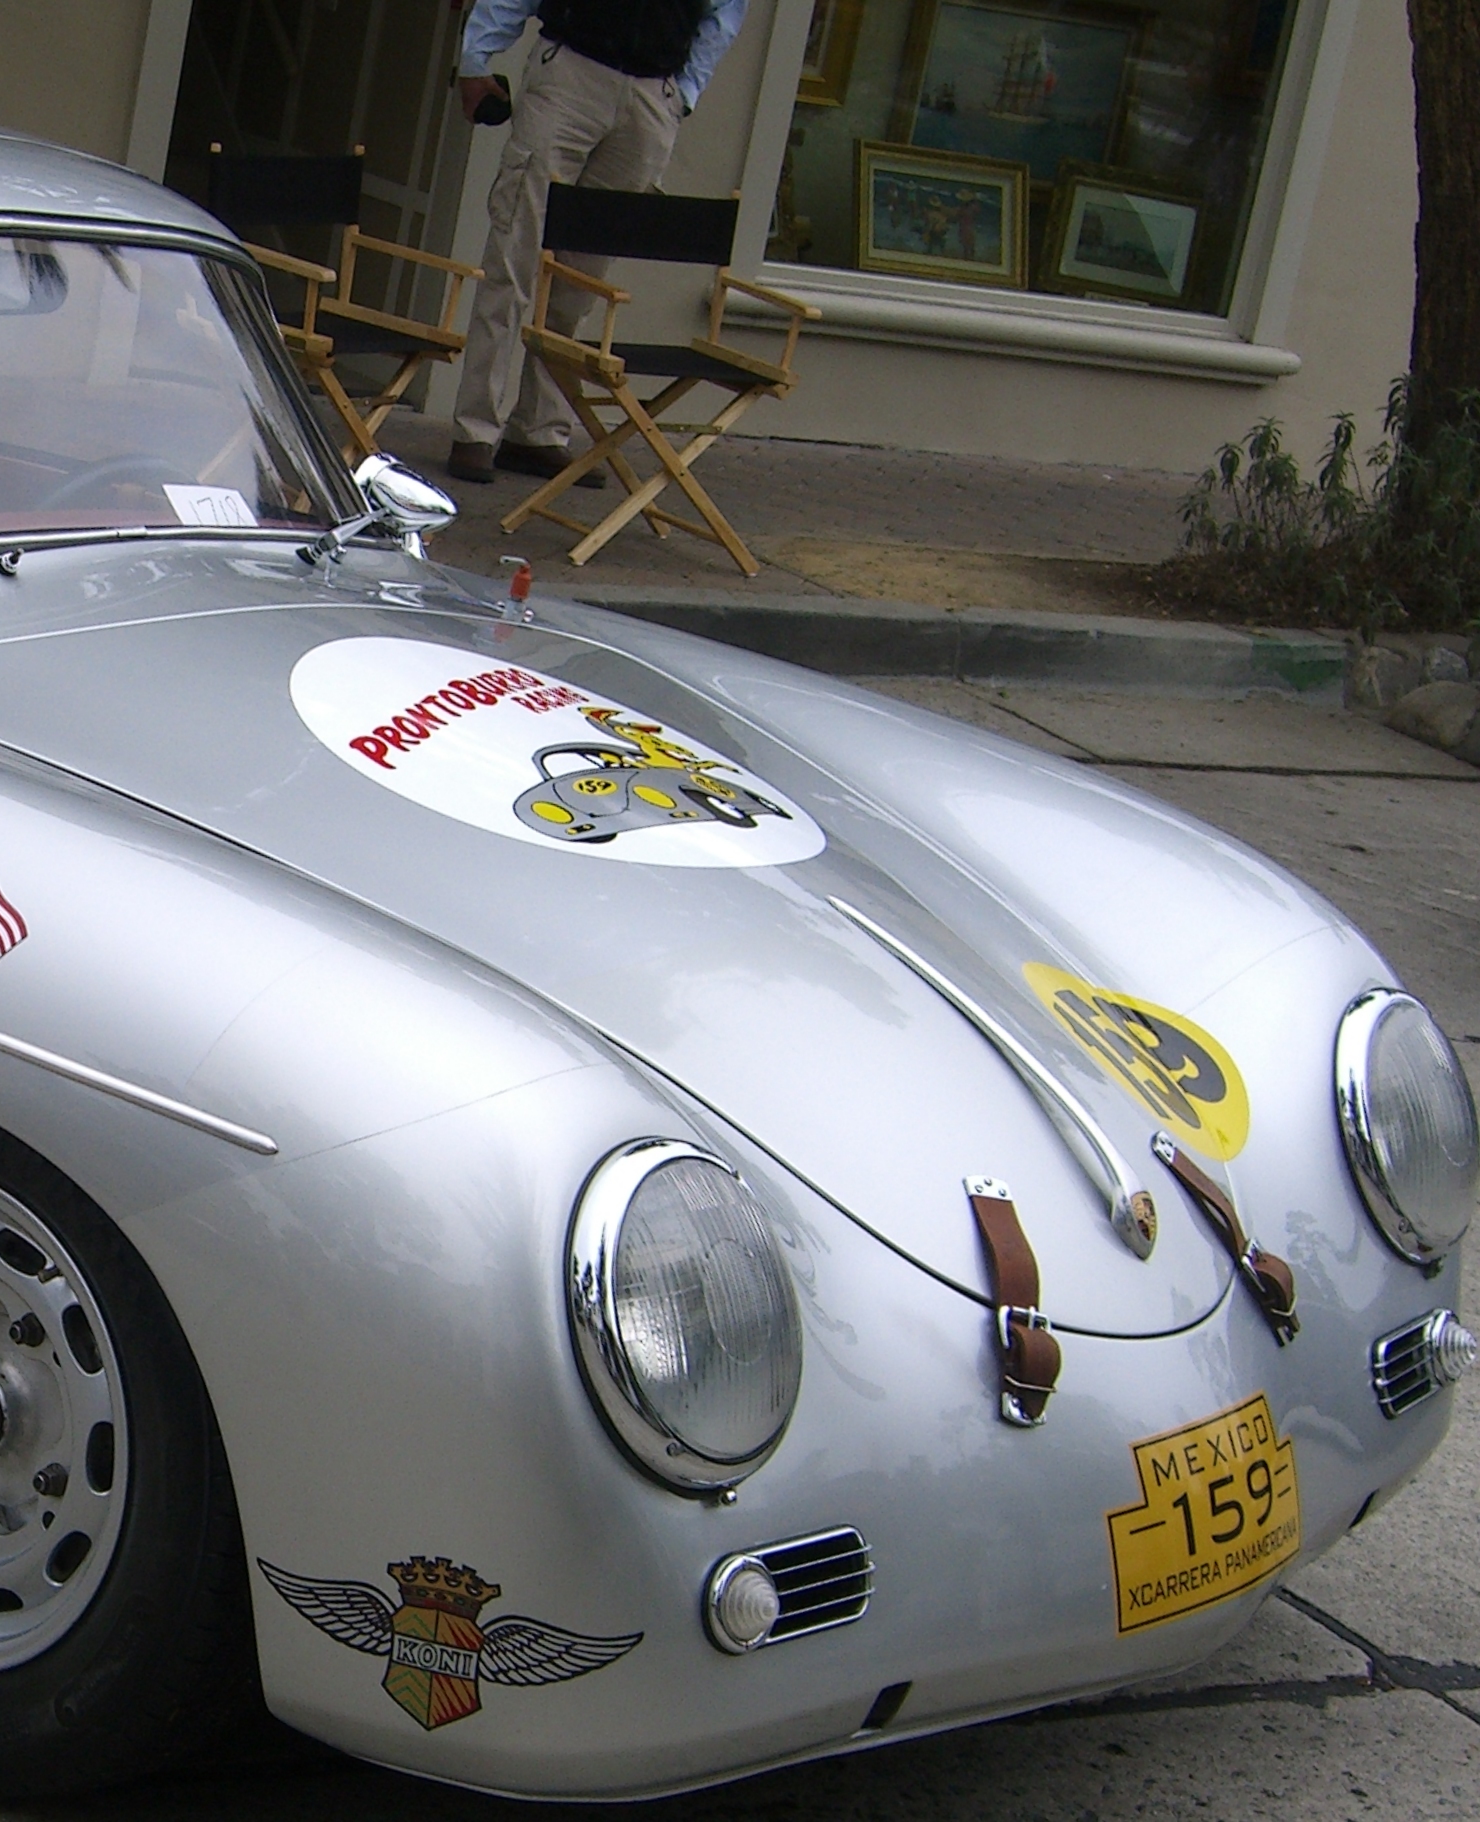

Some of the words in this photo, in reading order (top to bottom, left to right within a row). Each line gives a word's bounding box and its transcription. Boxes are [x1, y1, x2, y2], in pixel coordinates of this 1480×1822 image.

[578, 779, 612, 794] 159
[1053, 989, 1227, 1130] 159
[1151, 1414, 1269, 1487] MEXICO
[1172, 1458, 1273, 1557] 159
[1225, 1517, 1298, 1577] PANAMERICANA
[397, 1639, 474, 1677] KONI
